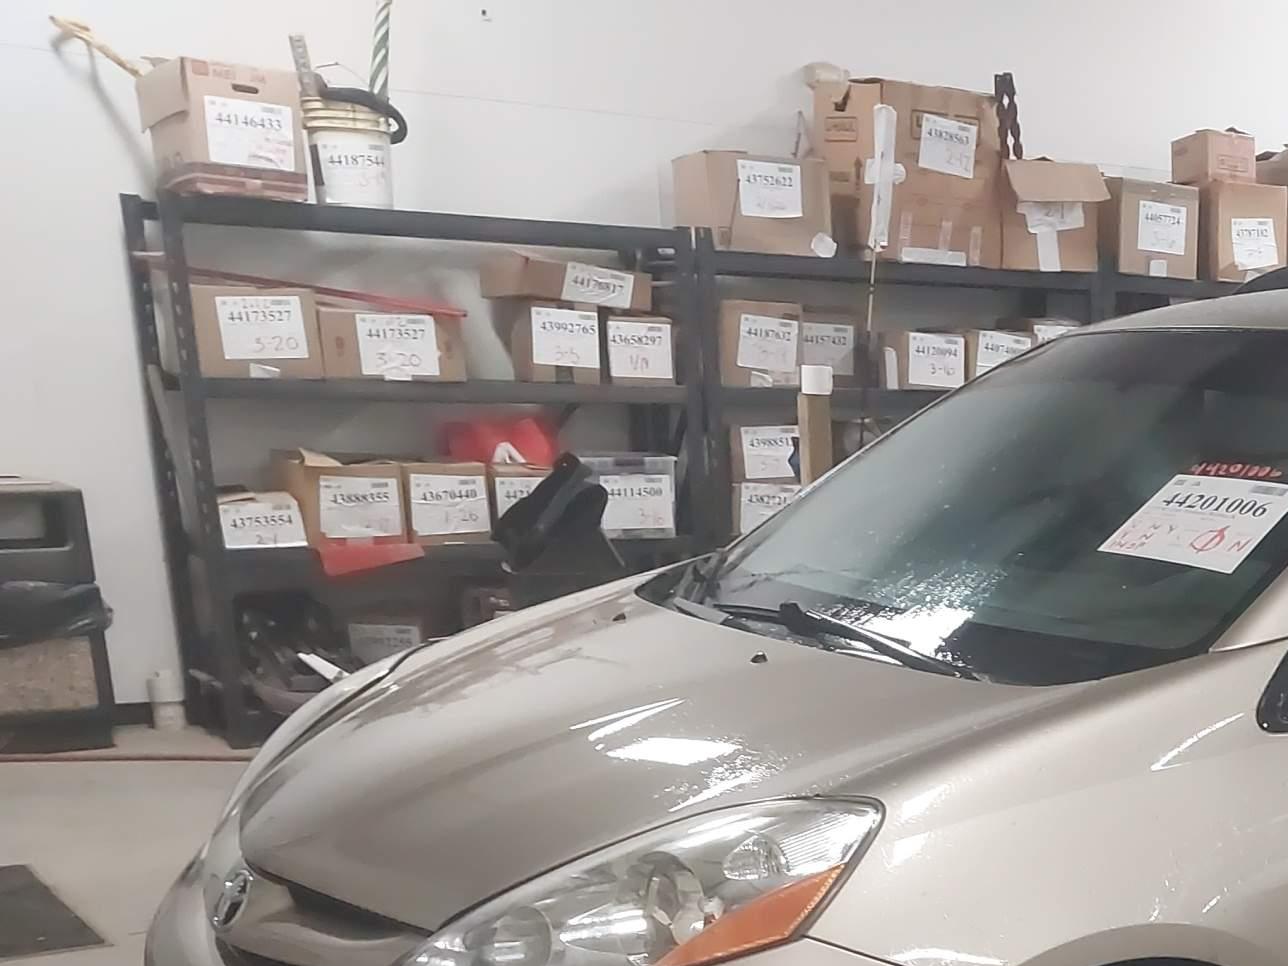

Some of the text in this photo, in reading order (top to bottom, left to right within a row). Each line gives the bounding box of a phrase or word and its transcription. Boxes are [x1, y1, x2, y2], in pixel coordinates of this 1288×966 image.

[214, 112, 283, 130] 44146433
[745, 173, 793, 188] 43752622
[227, 310, 292, 322] 44173527
[366, 328, 425, 341] 44173527
[540, 321, 596, 336] 43992765
[609, 334, 663, 346] 43658297
[749, 436, 795, 449] 4398851
[421, 488, 478, 502] 43670440
[607, 487, 663, 498] 44114500
[1162, 492, 1274, 518] 44201006
[230, 514, 293, 529] 43753554
